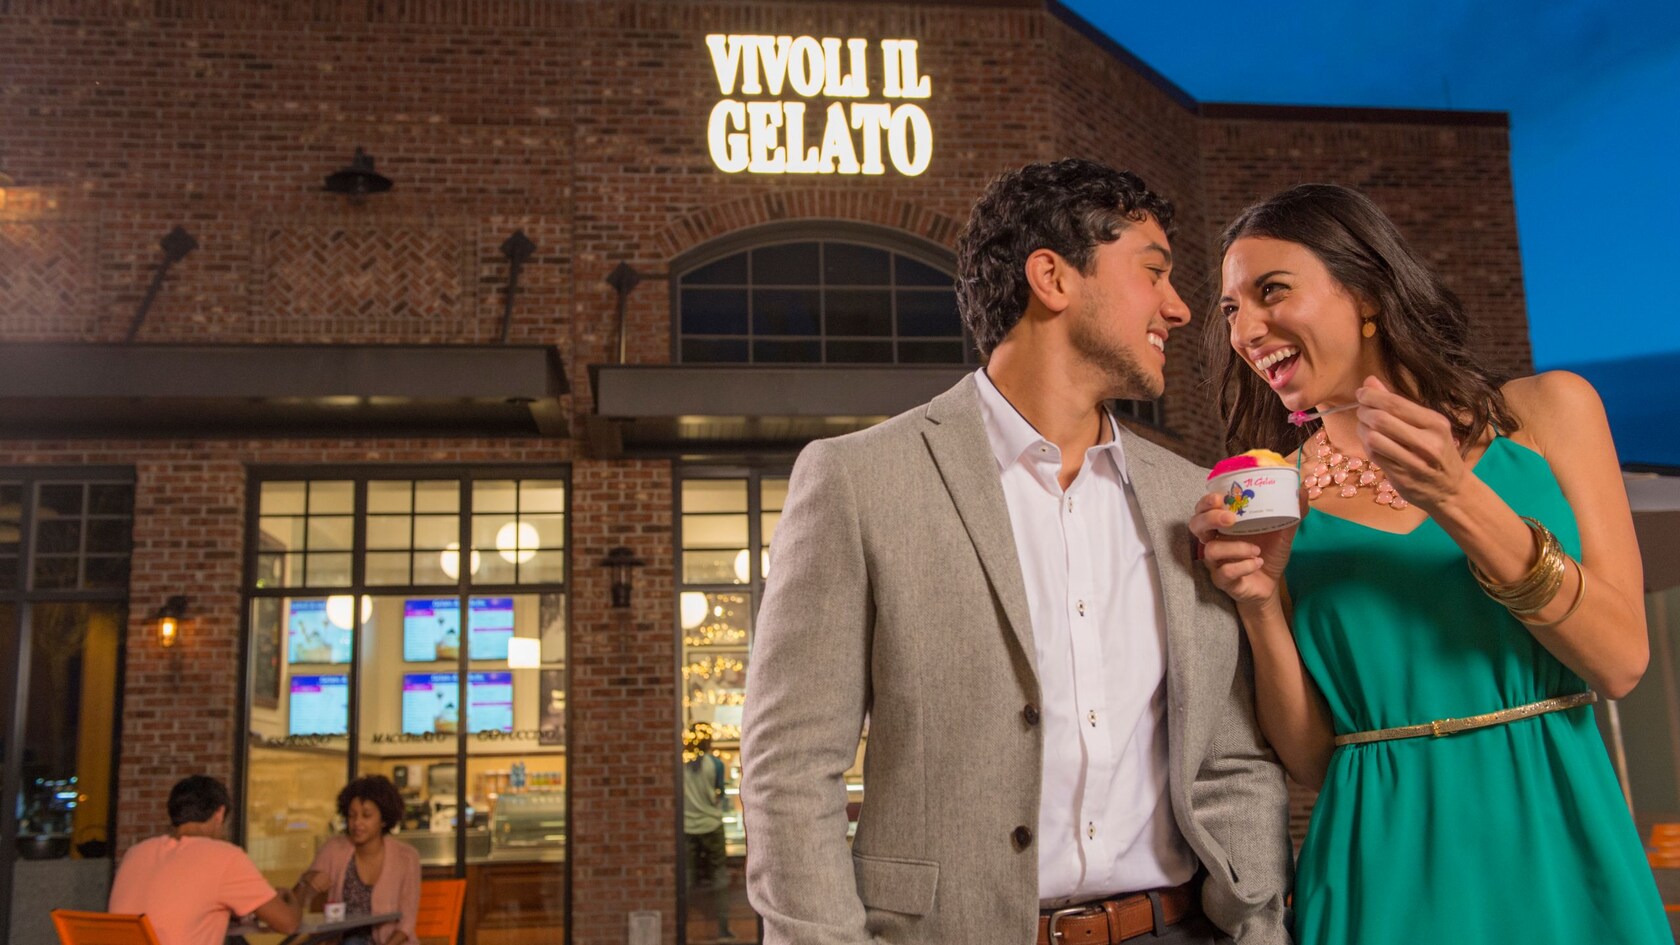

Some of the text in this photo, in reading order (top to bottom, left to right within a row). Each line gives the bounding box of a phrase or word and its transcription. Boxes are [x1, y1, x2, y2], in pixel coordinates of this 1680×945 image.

[706, 34, 931, 98] VIVOLI IL
[708, 99, 932, 176] GELATO
